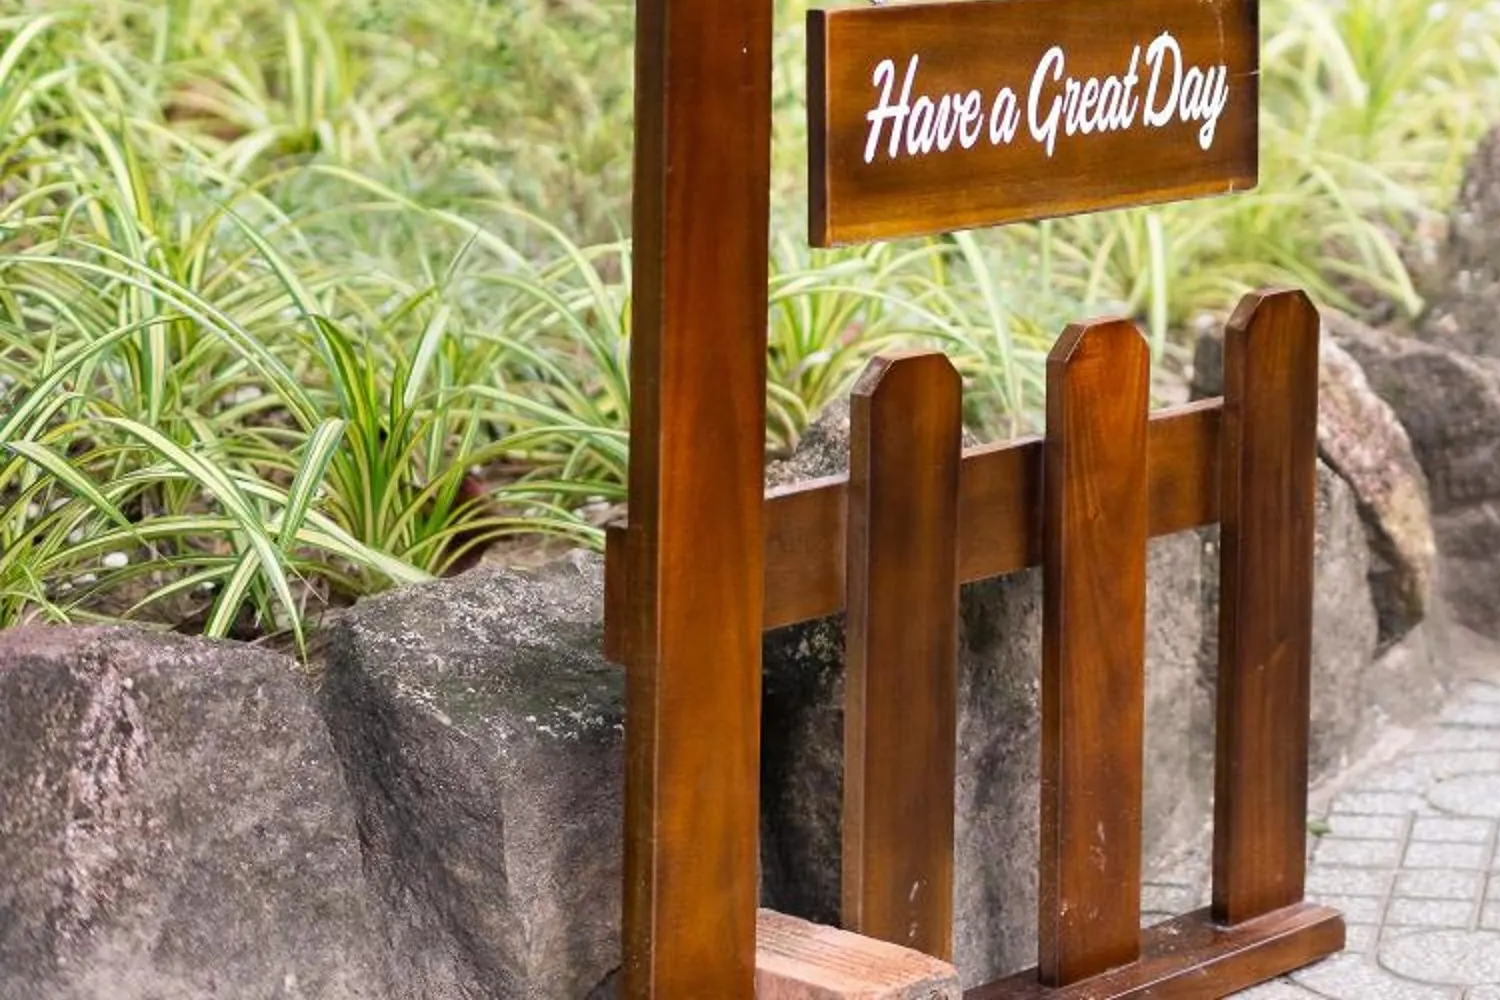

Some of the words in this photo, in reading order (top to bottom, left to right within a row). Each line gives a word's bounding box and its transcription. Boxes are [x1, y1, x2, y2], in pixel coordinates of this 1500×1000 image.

[863, 53, 984, 164] Have
[988, 86, 1021, 146] a
[1026, 44, 1141, 158] Great
[1142, 30, 1229, 151] Day
